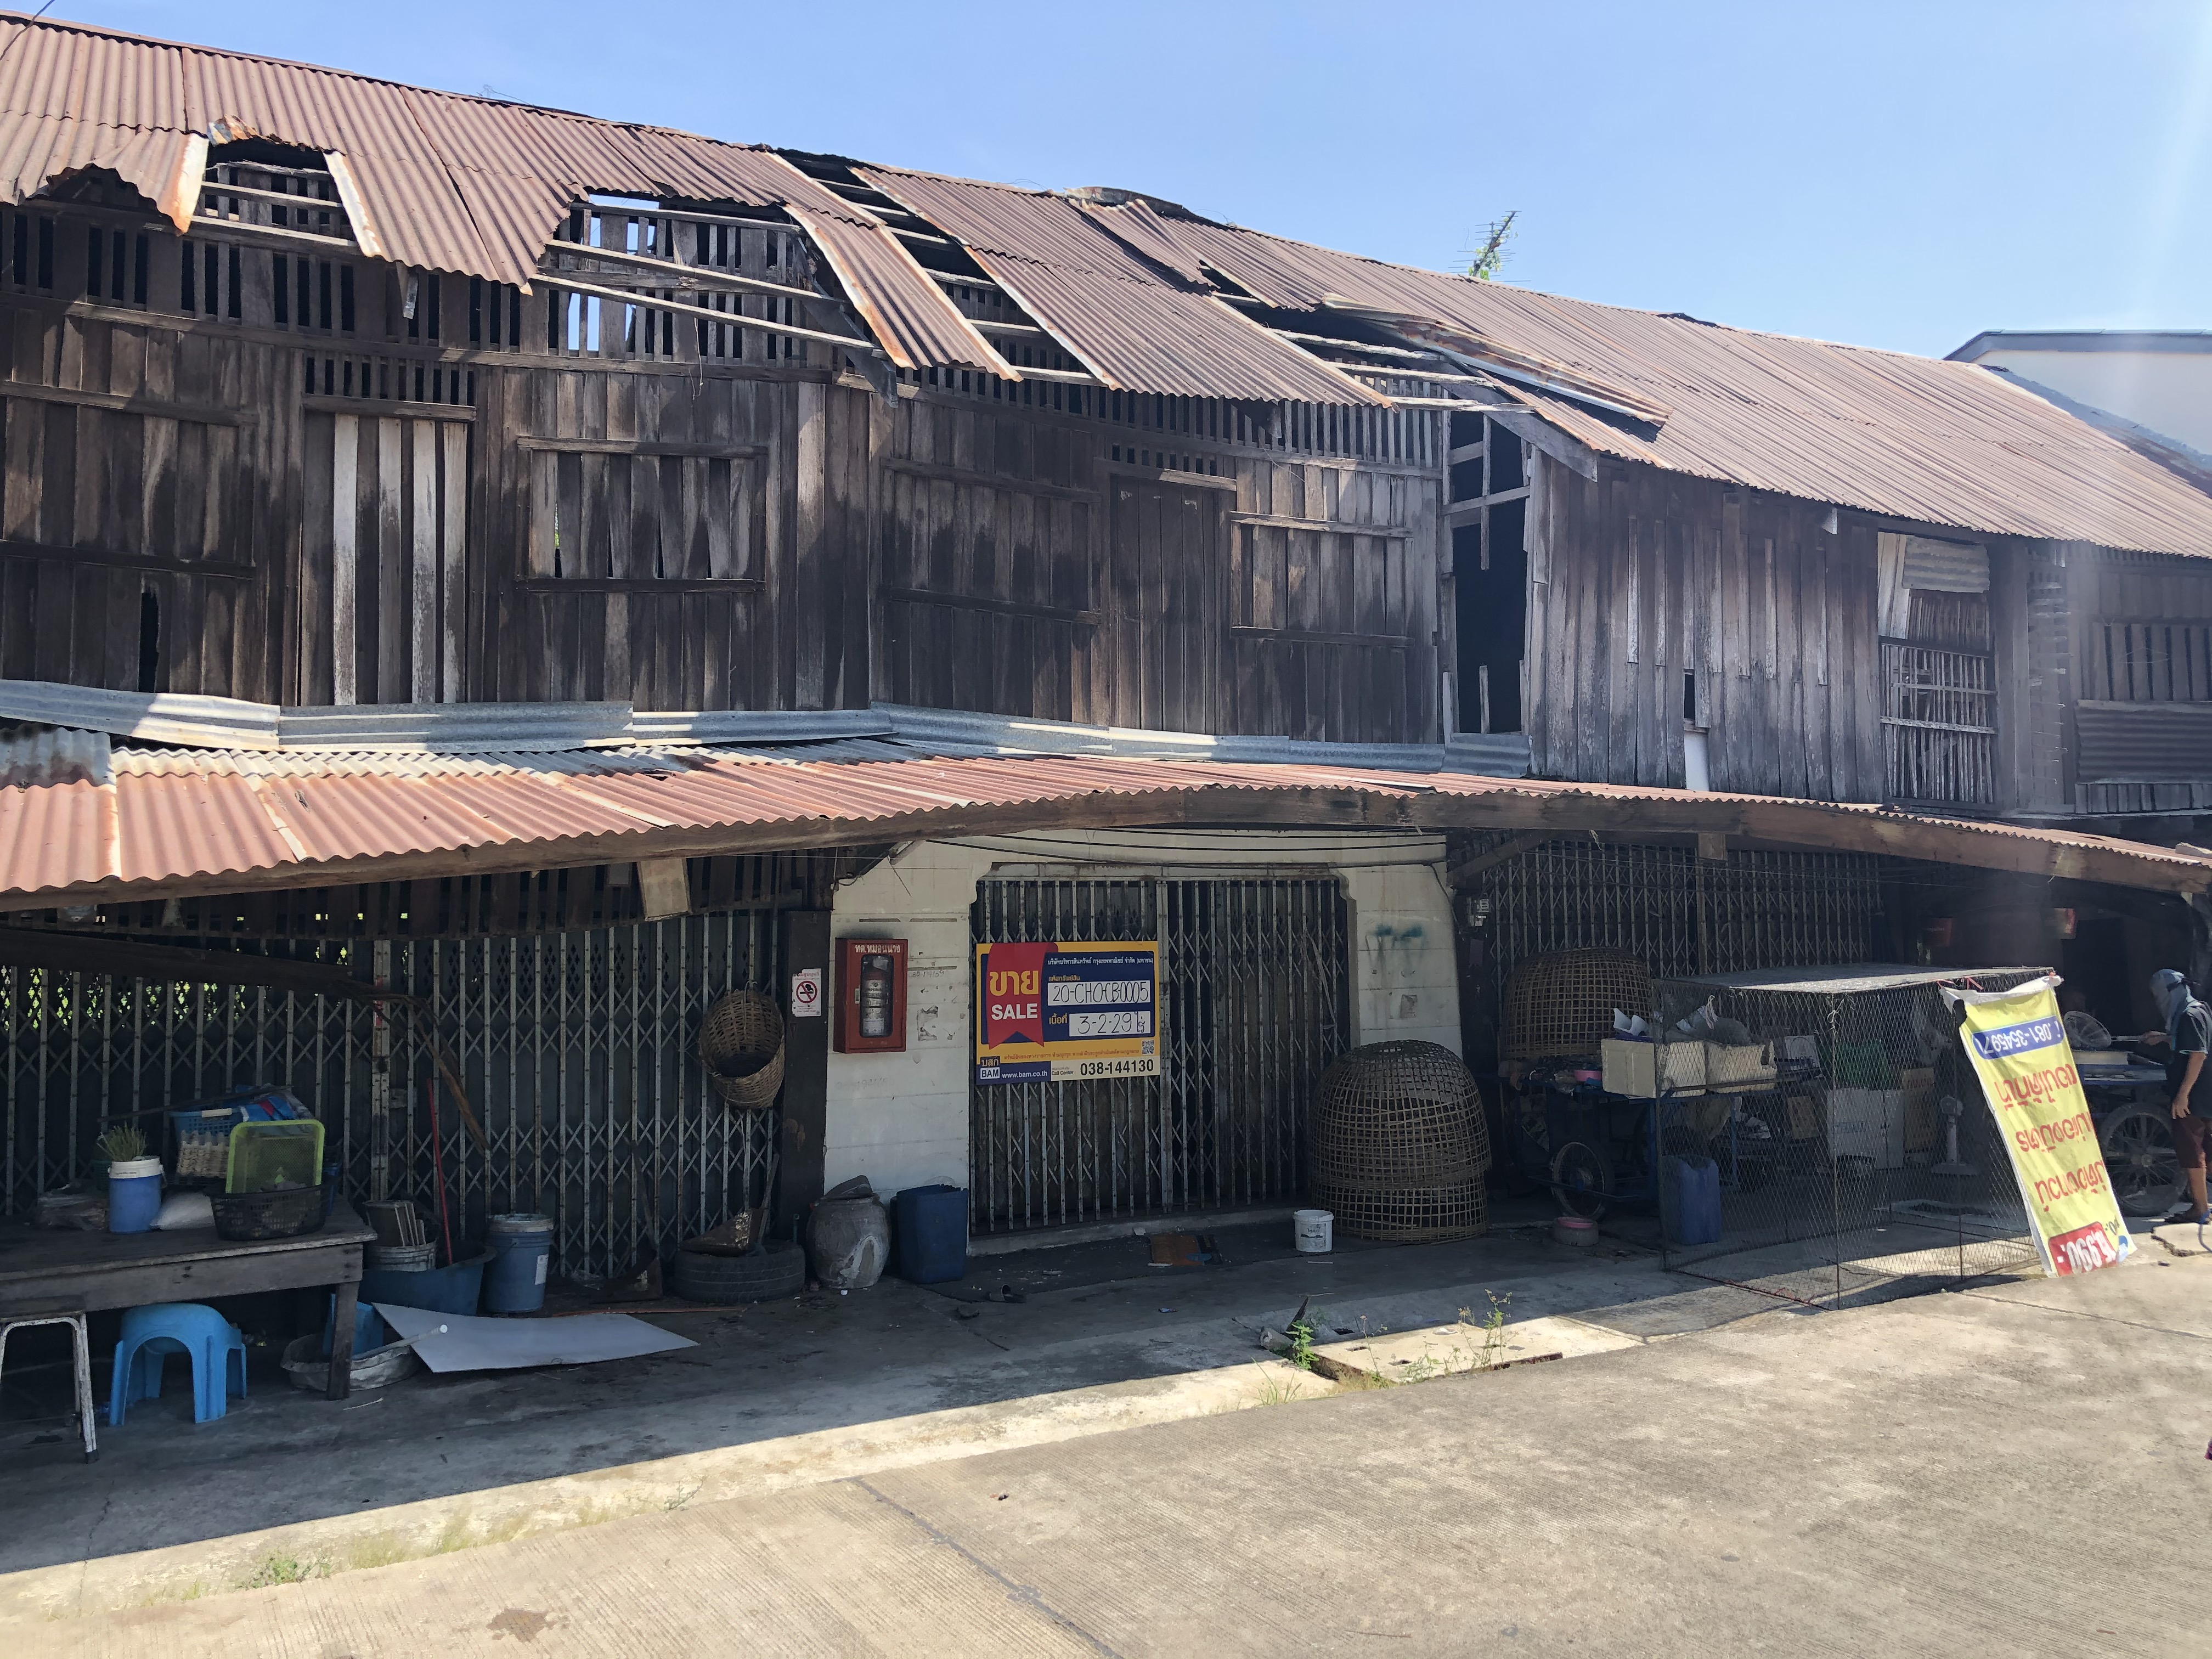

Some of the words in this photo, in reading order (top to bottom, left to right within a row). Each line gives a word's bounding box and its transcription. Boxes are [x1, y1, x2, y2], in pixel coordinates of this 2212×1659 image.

[990, 970, 1039, 996] ขาย
[991, 1003, 1038, 1020] SALE
[1048, 1013, 1068, 1025] เนื้อที่
[1077, 1012, 1132, 1034] 3-2-29
[981, 1068, 999, 1077] BAM
[1002, 1070, 1048, 1079] www.bam.co.th
[1080, 1059, 1154, 1076] 038-144130
